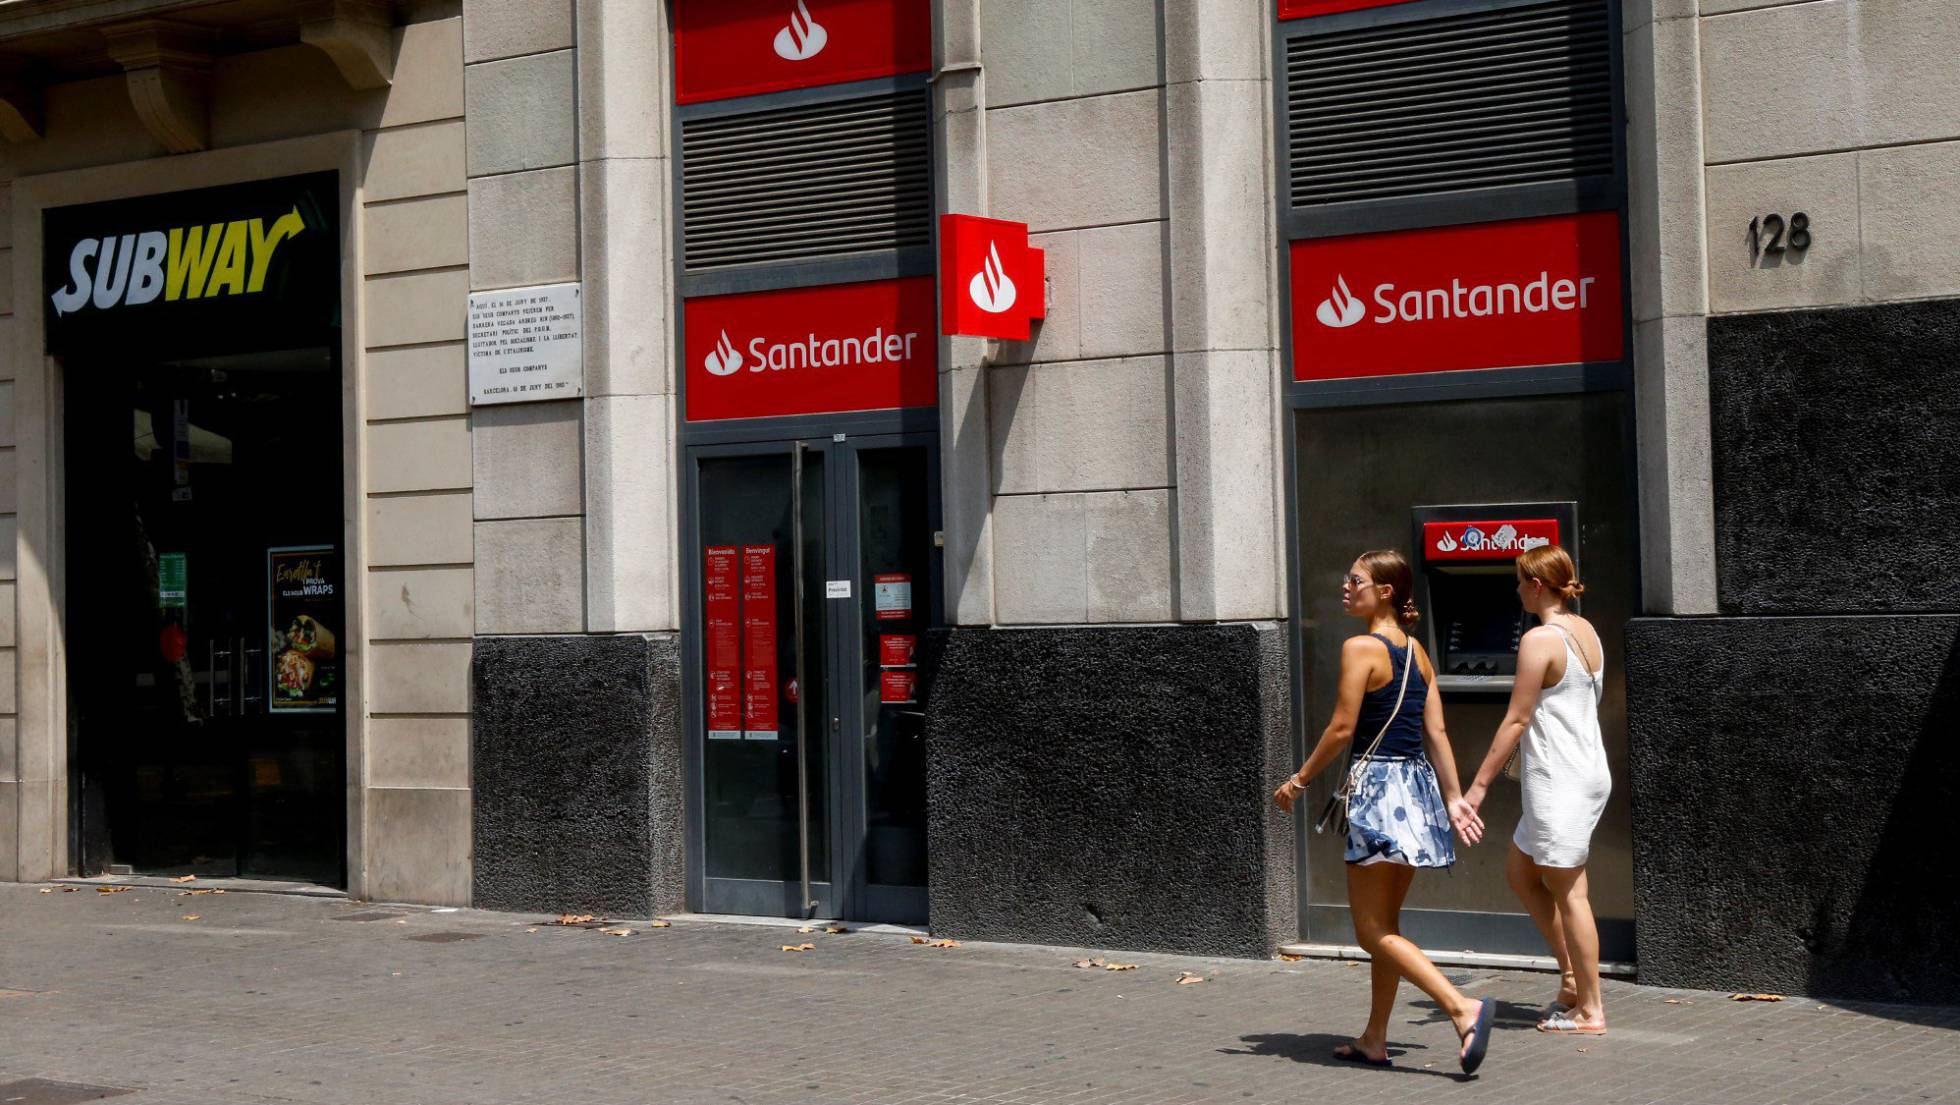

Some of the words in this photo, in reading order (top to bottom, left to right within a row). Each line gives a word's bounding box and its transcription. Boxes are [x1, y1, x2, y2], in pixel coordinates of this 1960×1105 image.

[1748, 211, 1811, 257] 128
[51, 204, 306, 319] SUBWAY
[1373, 271, 1595, 324] Santander
[749, 327, 918, 373] Santander
[303, 584, 334, 595] WRAPS
